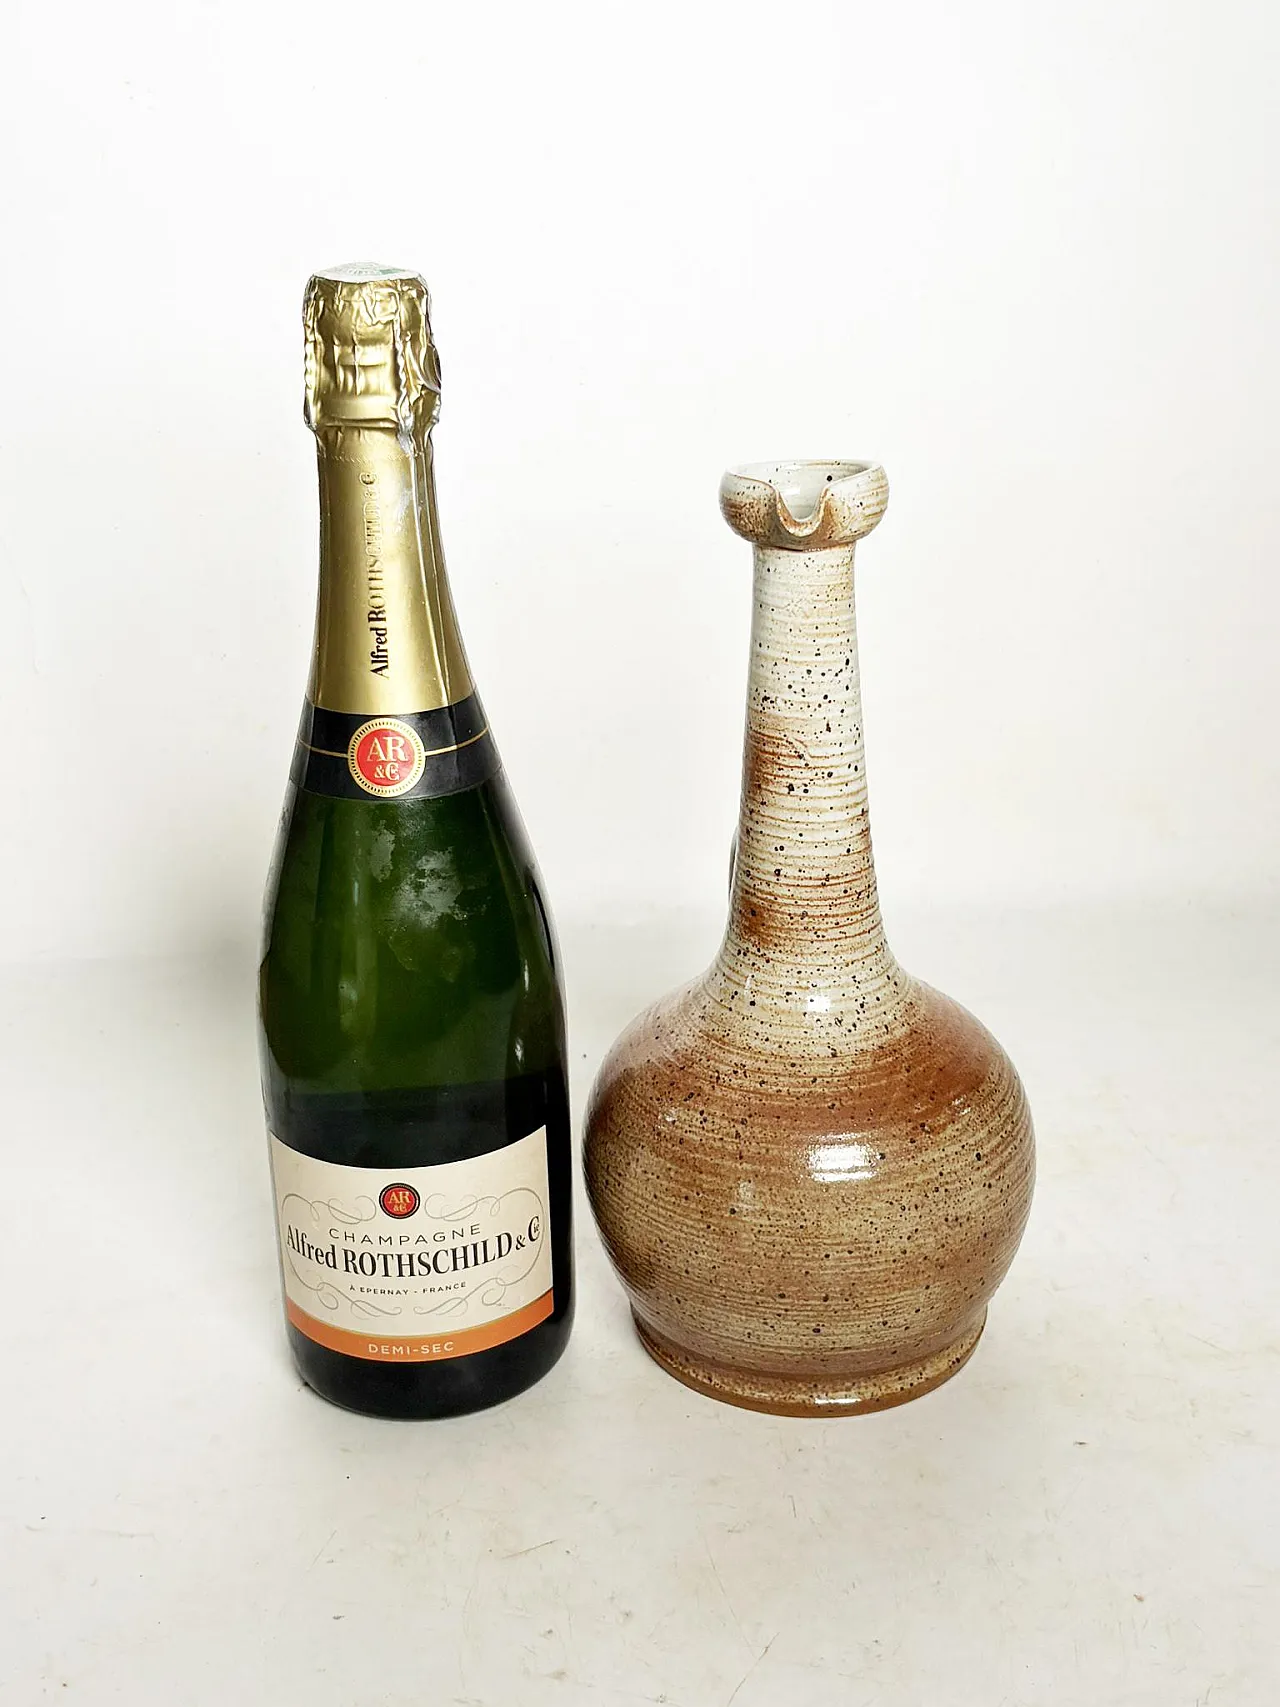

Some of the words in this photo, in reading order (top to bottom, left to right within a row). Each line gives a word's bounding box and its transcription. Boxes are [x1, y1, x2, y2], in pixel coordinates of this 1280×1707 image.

[369, 627, 390, 679] Alfred
[366, 736, 409, 762] AR
[389, 1191, 410, 1204] AR
[329, 1223, 482, 1246] CHAMPAGNE
[287, 1224, 338, 1270] Alfred
[360, 1286, 409, 1295] EPERNAY
[422, 1281, 467, 1294] FRANCE
[368, 1341, 454, 1355] DEMI-SEC
